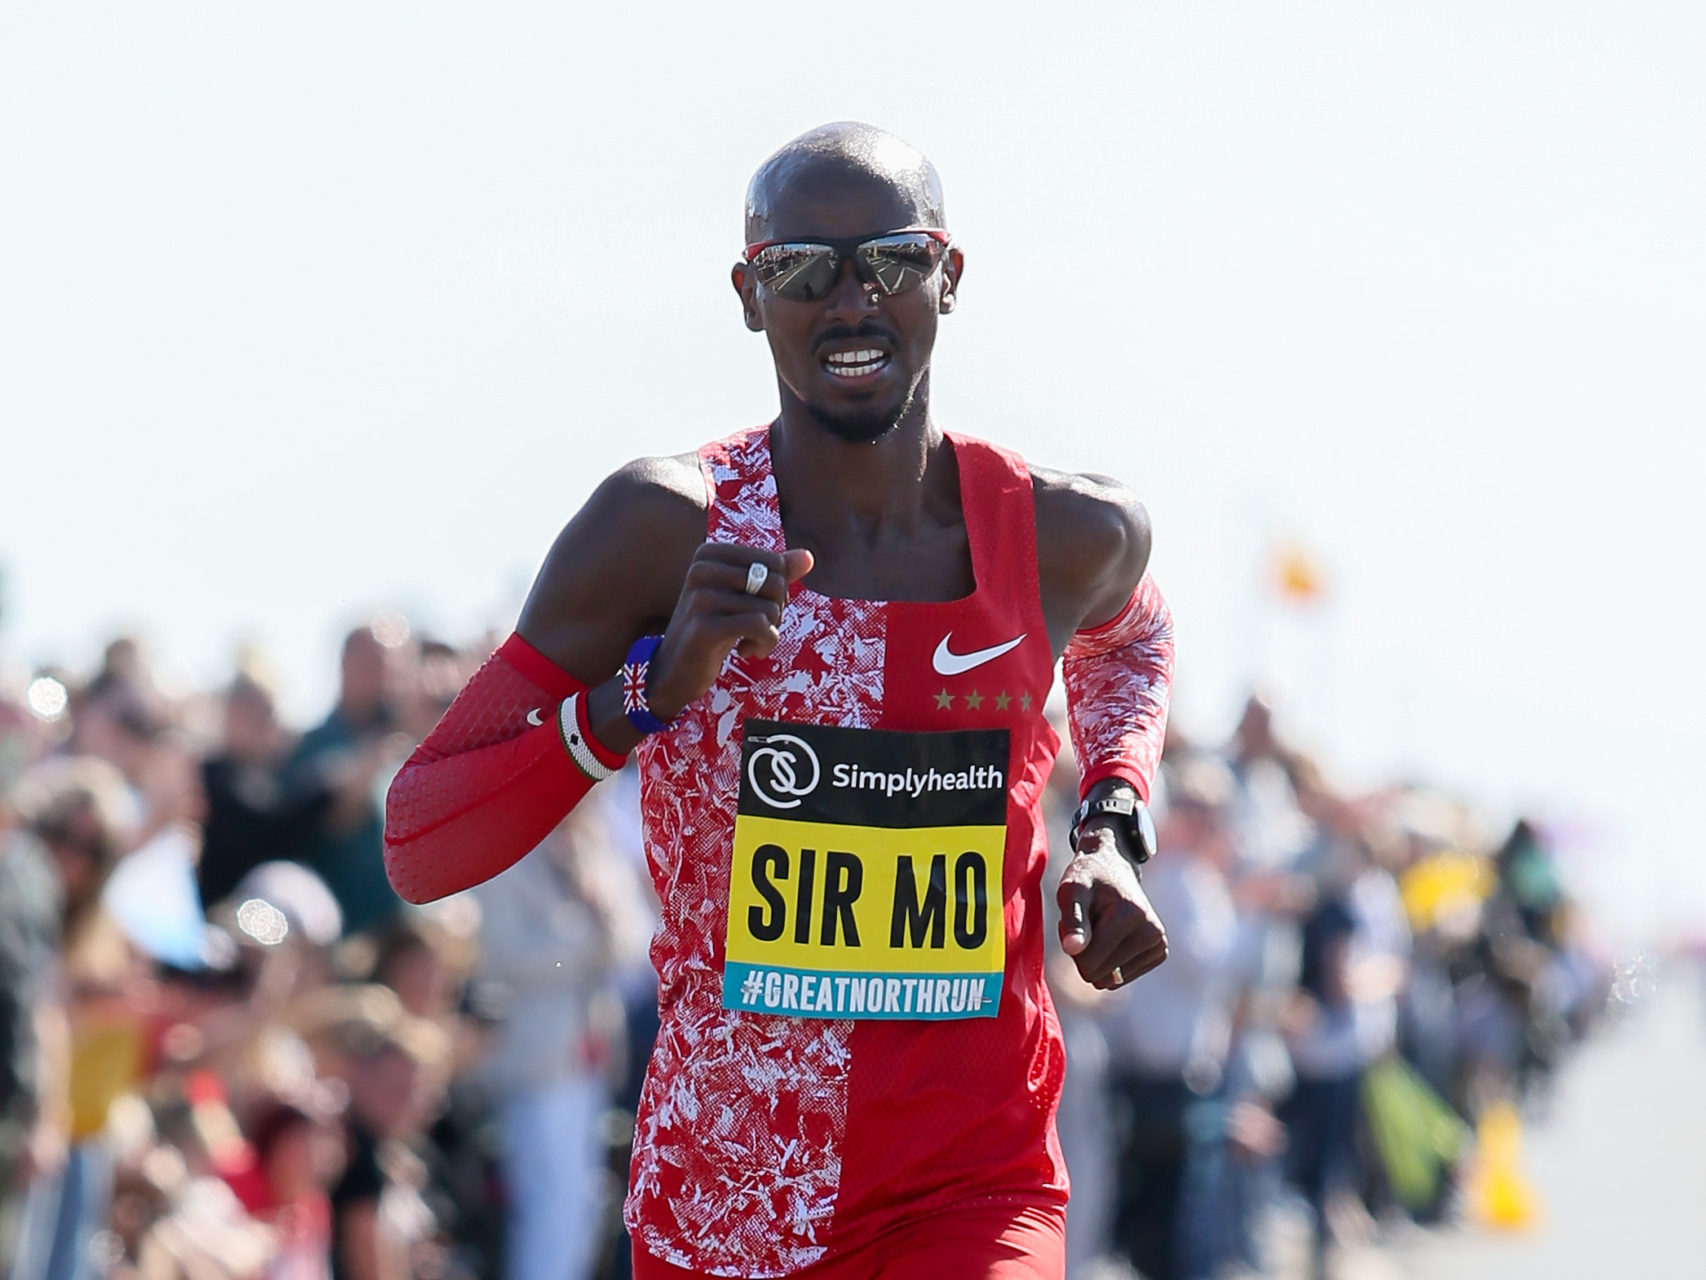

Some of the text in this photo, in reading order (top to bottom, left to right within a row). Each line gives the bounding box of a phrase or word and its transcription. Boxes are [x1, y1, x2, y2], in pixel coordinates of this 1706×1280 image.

[832, 763, 1003, 798] Simplyhealth
[747, 844, 988, 950] SIR MO
[741, 970, 986, 1013] #GREATNORTHRUN
